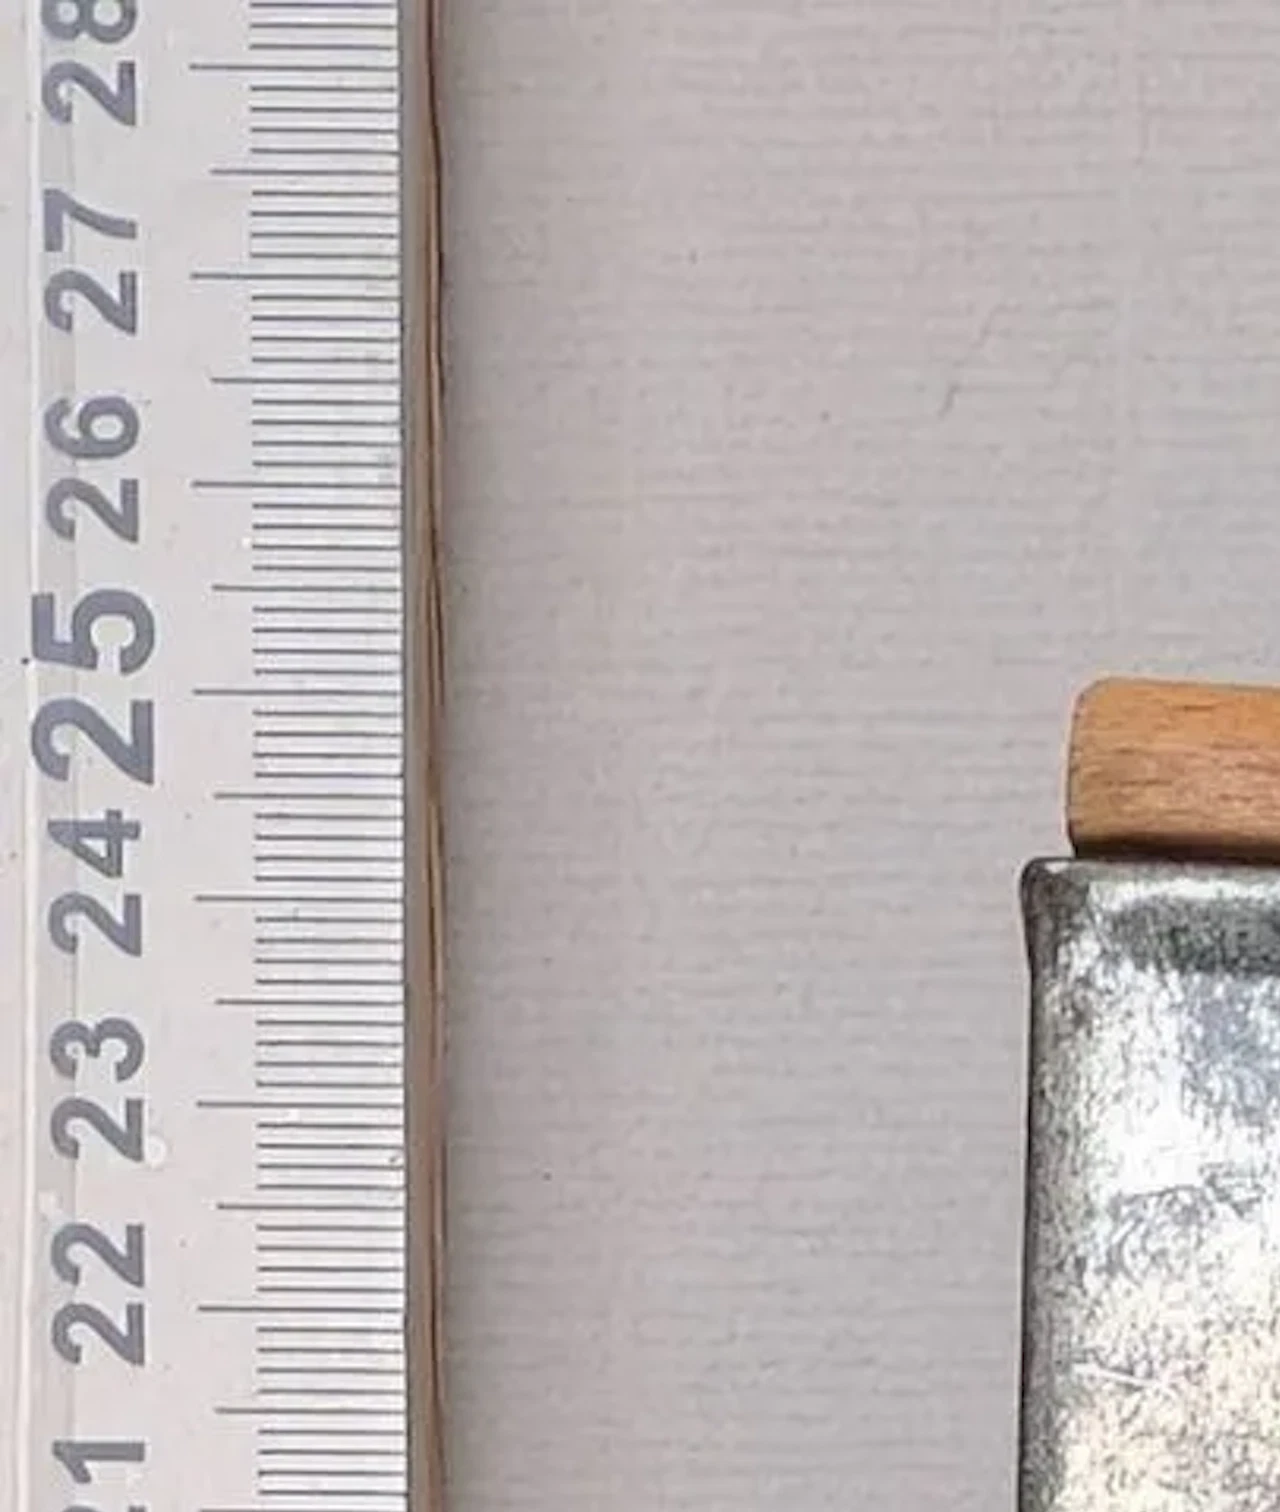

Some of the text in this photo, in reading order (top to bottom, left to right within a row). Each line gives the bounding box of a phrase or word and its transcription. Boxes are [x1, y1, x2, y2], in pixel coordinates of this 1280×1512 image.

[43, 189, 137, 336] 27
[44, 397, 139, 543] 26
[31, 590, 155, 785] 25
[47, 810, 142, 957] 24
[49, 1018, 144, 1162] 23
[50, 1223, 145, 1367] 22
